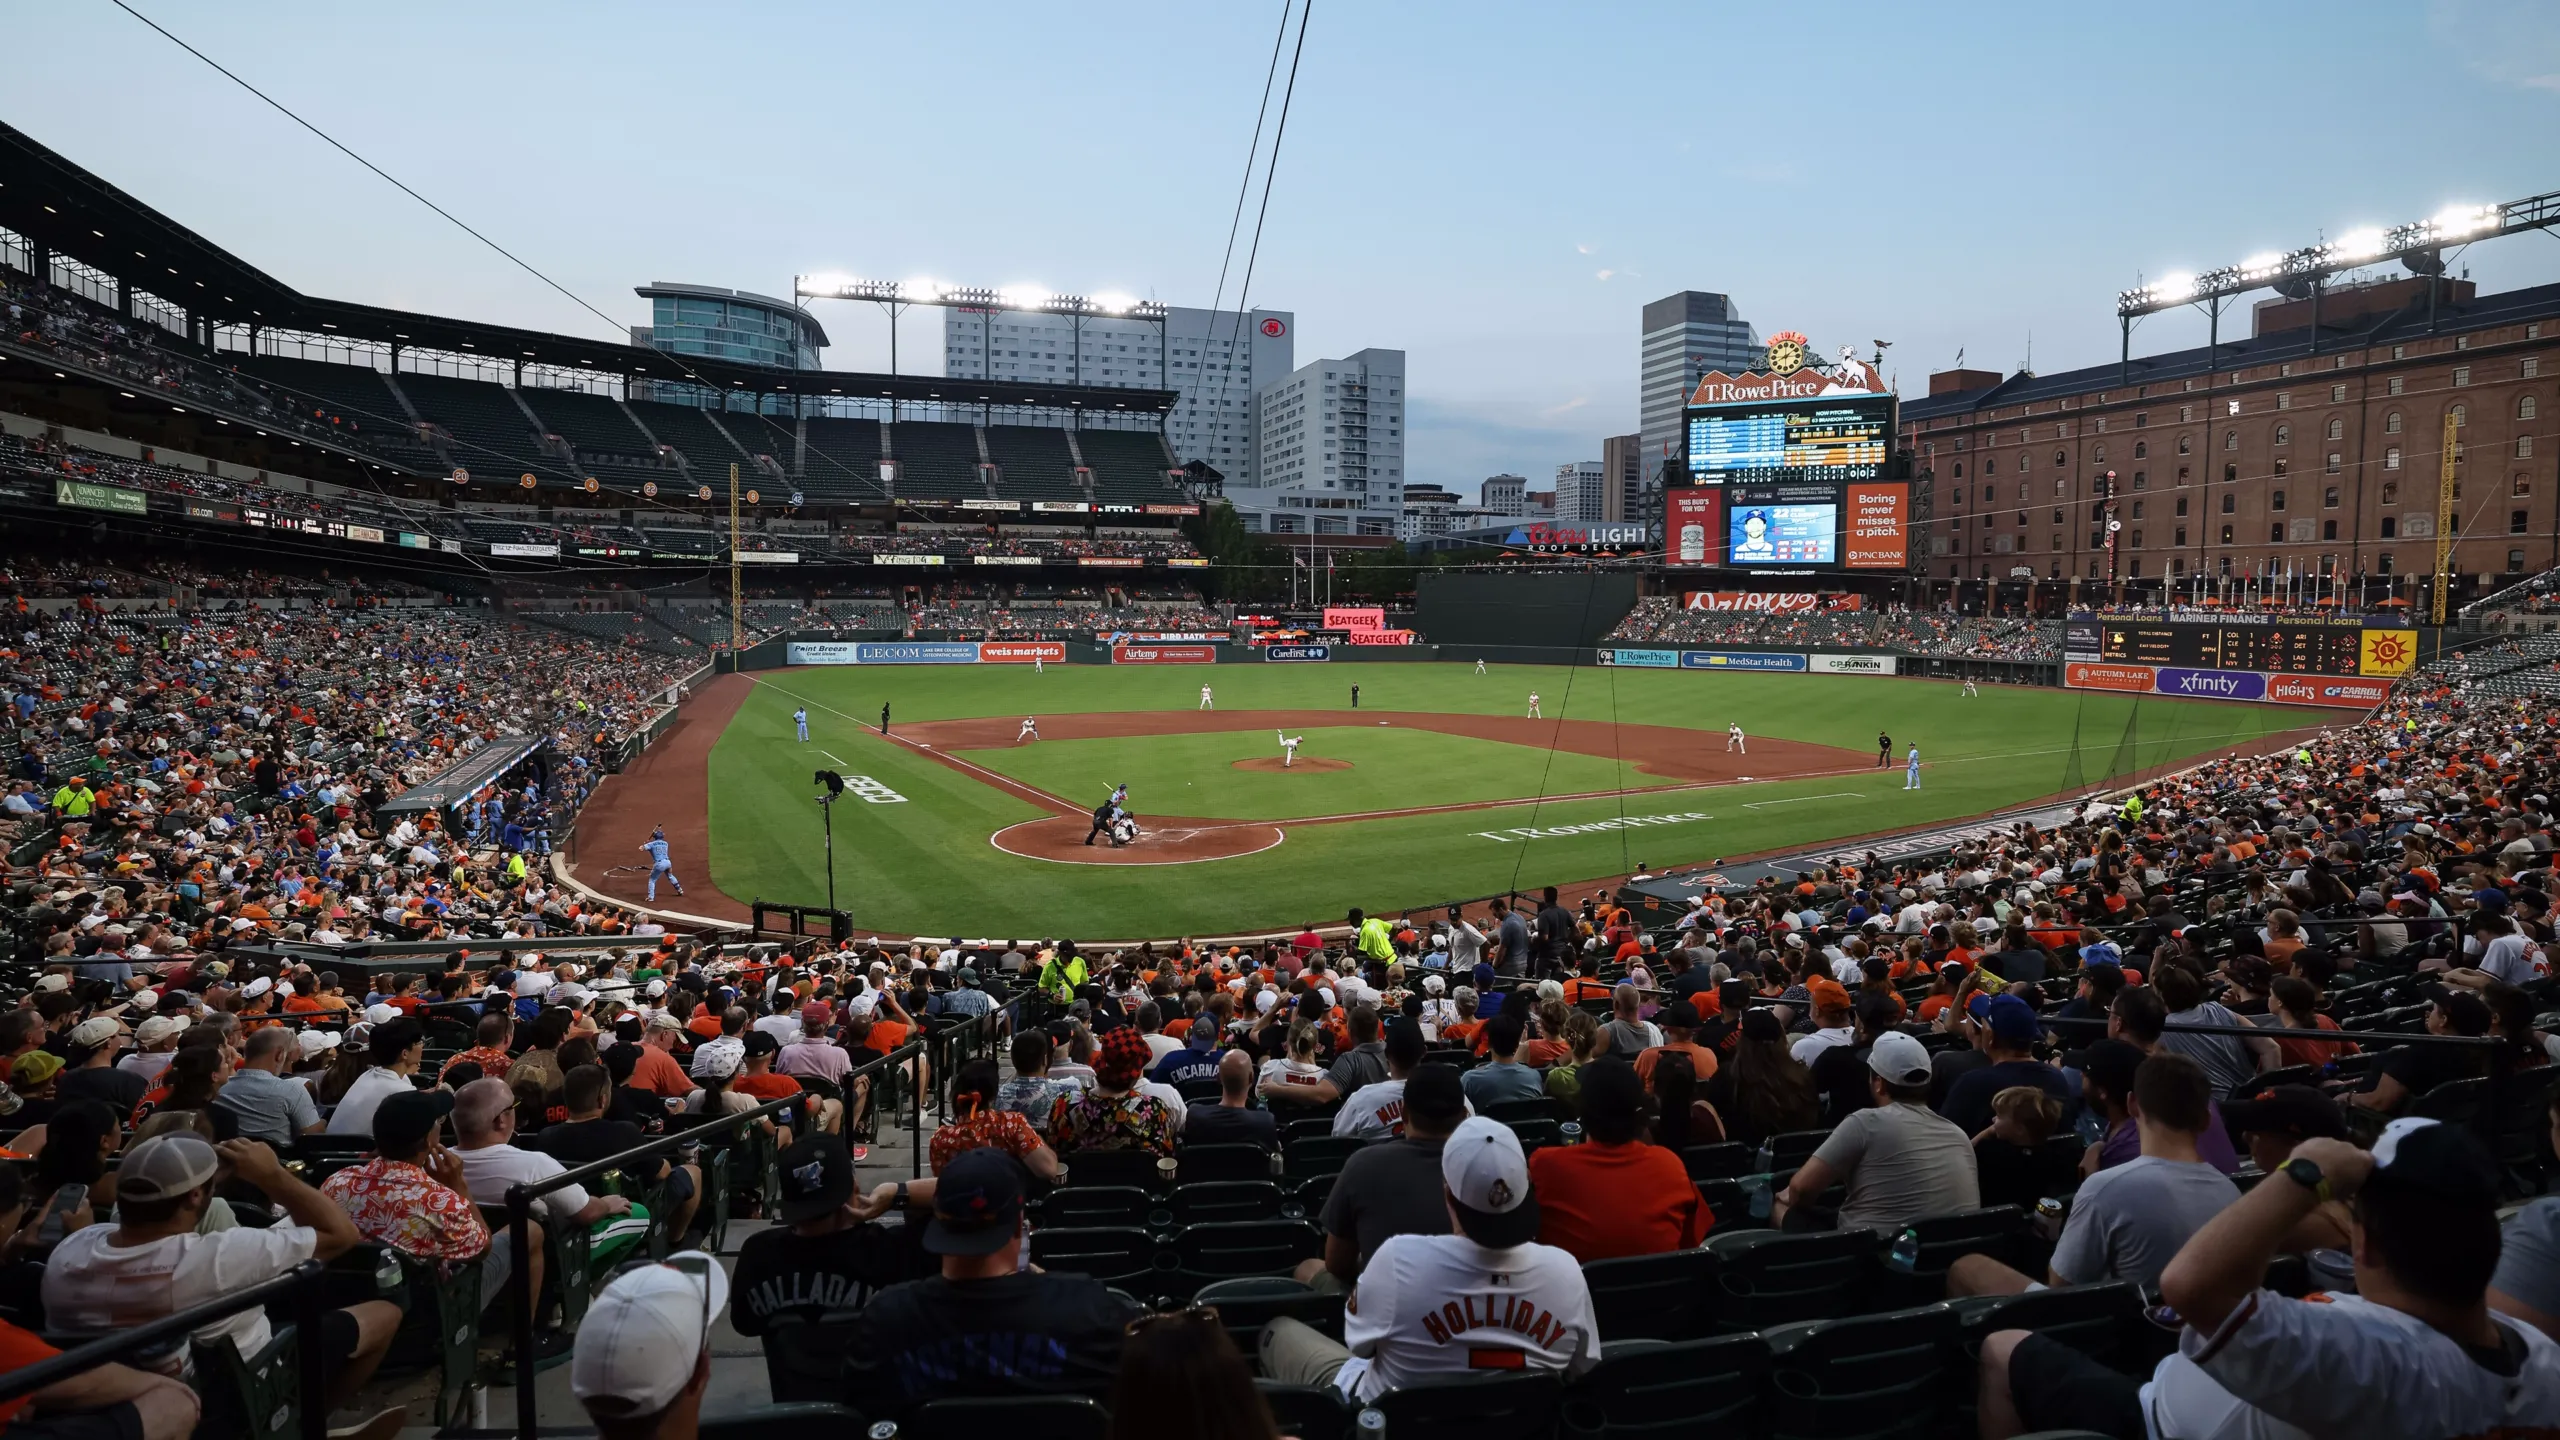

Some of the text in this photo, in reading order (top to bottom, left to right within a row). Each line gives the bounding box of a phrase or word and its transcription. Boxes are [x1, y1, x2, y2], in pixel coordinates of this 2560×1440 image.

[456, 472, 466, 481] 20
[1870, 469, 1876, 477] 2
[526, 476, 532, 486] 5
[589, 480, 594, 490] 4
[76, 485, 105, 497] ADVANCED
[645, 485, 656, 494] 22
[701, 489, 711, 498] 33
[115, 492, 126, 500] Proud
[751, 492, 756, 501] 8
[793, 494, 802, 503] 42
[1859, 494, 1896, 505] Boring
[1772, 508, 1790, 518] 22
[1858, 516, 1896, 525] misses
[1530, 522, 1646, 544] Coors LIGHT
[1867, 527, 1899, 538] pitch.
[1014, 556, 1041, 564] UNION
[2011, 566, 2031, 577] BOOGS
[1329, 614, 1378, 628] SEATGEEK
[2097, 612, 2363, 625] Personal Loans MARINER FINANCE Personal Loans
[1351, 633, 1402, 645] SEATGEEK
[986, 647, 1059, 656] weis markets
[1125, 648, 1158, 659] Airtemp
[1272, 649, 1306, 658] CareFirst
[1728, 657, 1793, 667] MedStar Health
[2091, 669, 2149, 680] AUTUMN LAKE
[2180, 673, 2238, 695] xfinity
[2276, 684, 2315, 699] HIGH'S
[2342, 686, 2382, 696] CARROLL
[746, 1272, 880, 1317] HALLADAY
[1422, 1293, 1567, 1350] HOLLIDAY
